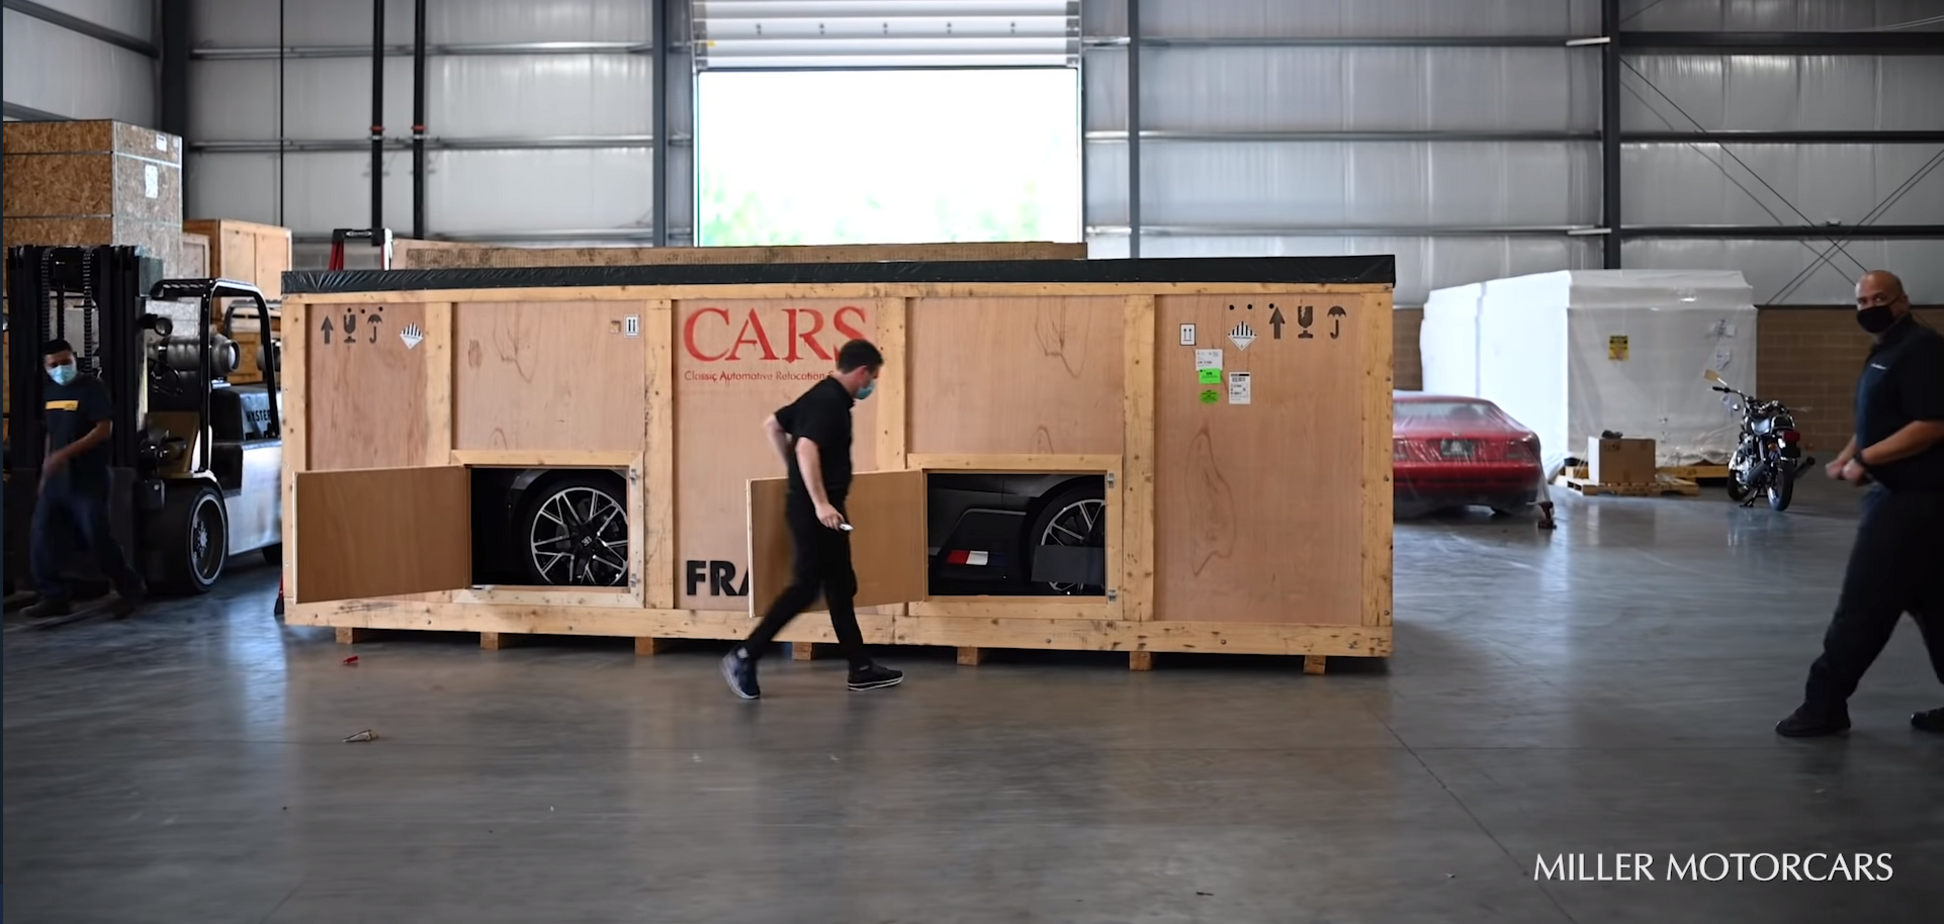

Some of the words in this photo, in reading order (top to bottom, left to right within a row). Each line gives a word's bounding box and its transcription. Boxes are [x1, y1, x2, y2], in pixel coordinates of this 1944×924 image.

[683, 306, 866, 364] CARS
[684, 370, 717, 382] Classic
[720, 370, 773, 381] Automotive
[775, 370, 825, 381] Relocation
